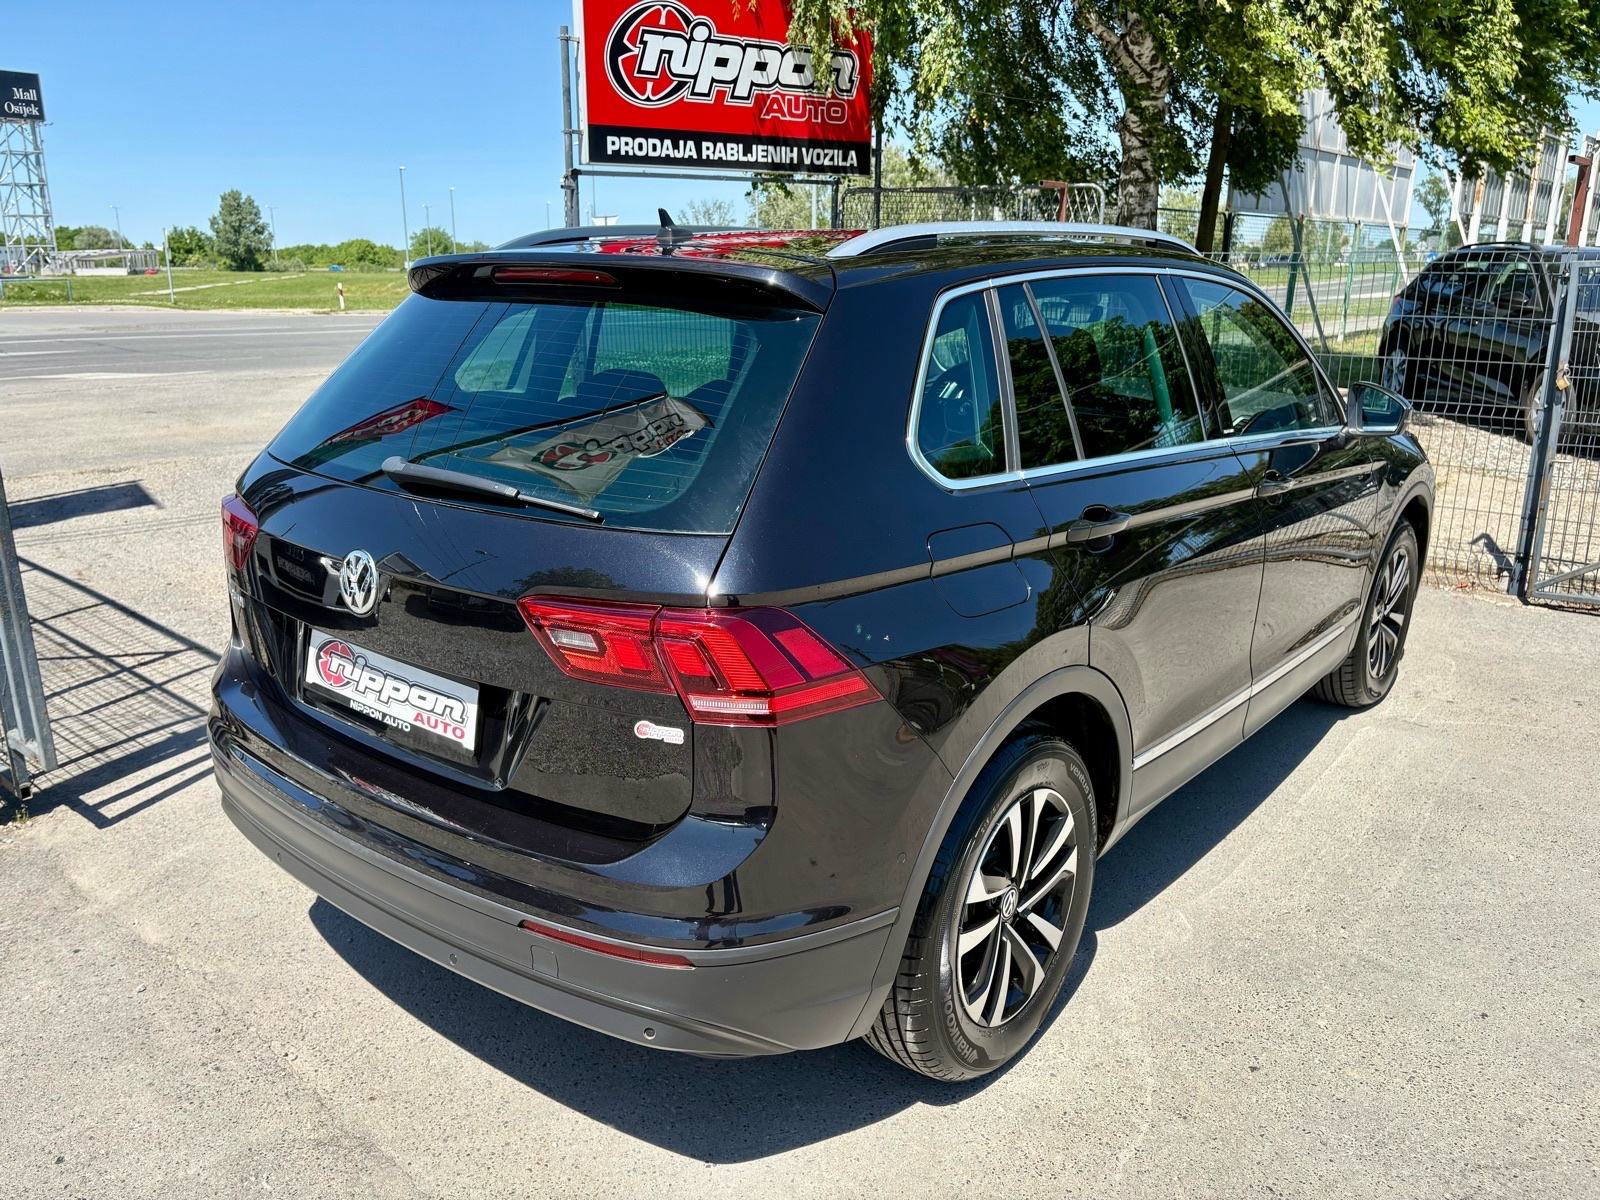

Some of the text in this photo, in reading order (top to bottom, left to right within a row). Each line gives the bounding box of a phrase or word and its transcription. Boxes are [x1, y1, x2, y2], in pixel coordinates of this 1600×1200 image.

[4, 101, 40, 117] Osijek
[12, 87, 38, 101] Mall
[760, 94, 848, 125] AUTO
[606, 135, 858, 167] PRODAJA RABLJENIH VOZILA
[327, 653, 468, 726] nippon
[350, 700, 411, 733] NIPPON AUTO
[413, 712, 465, 740] AUTO
